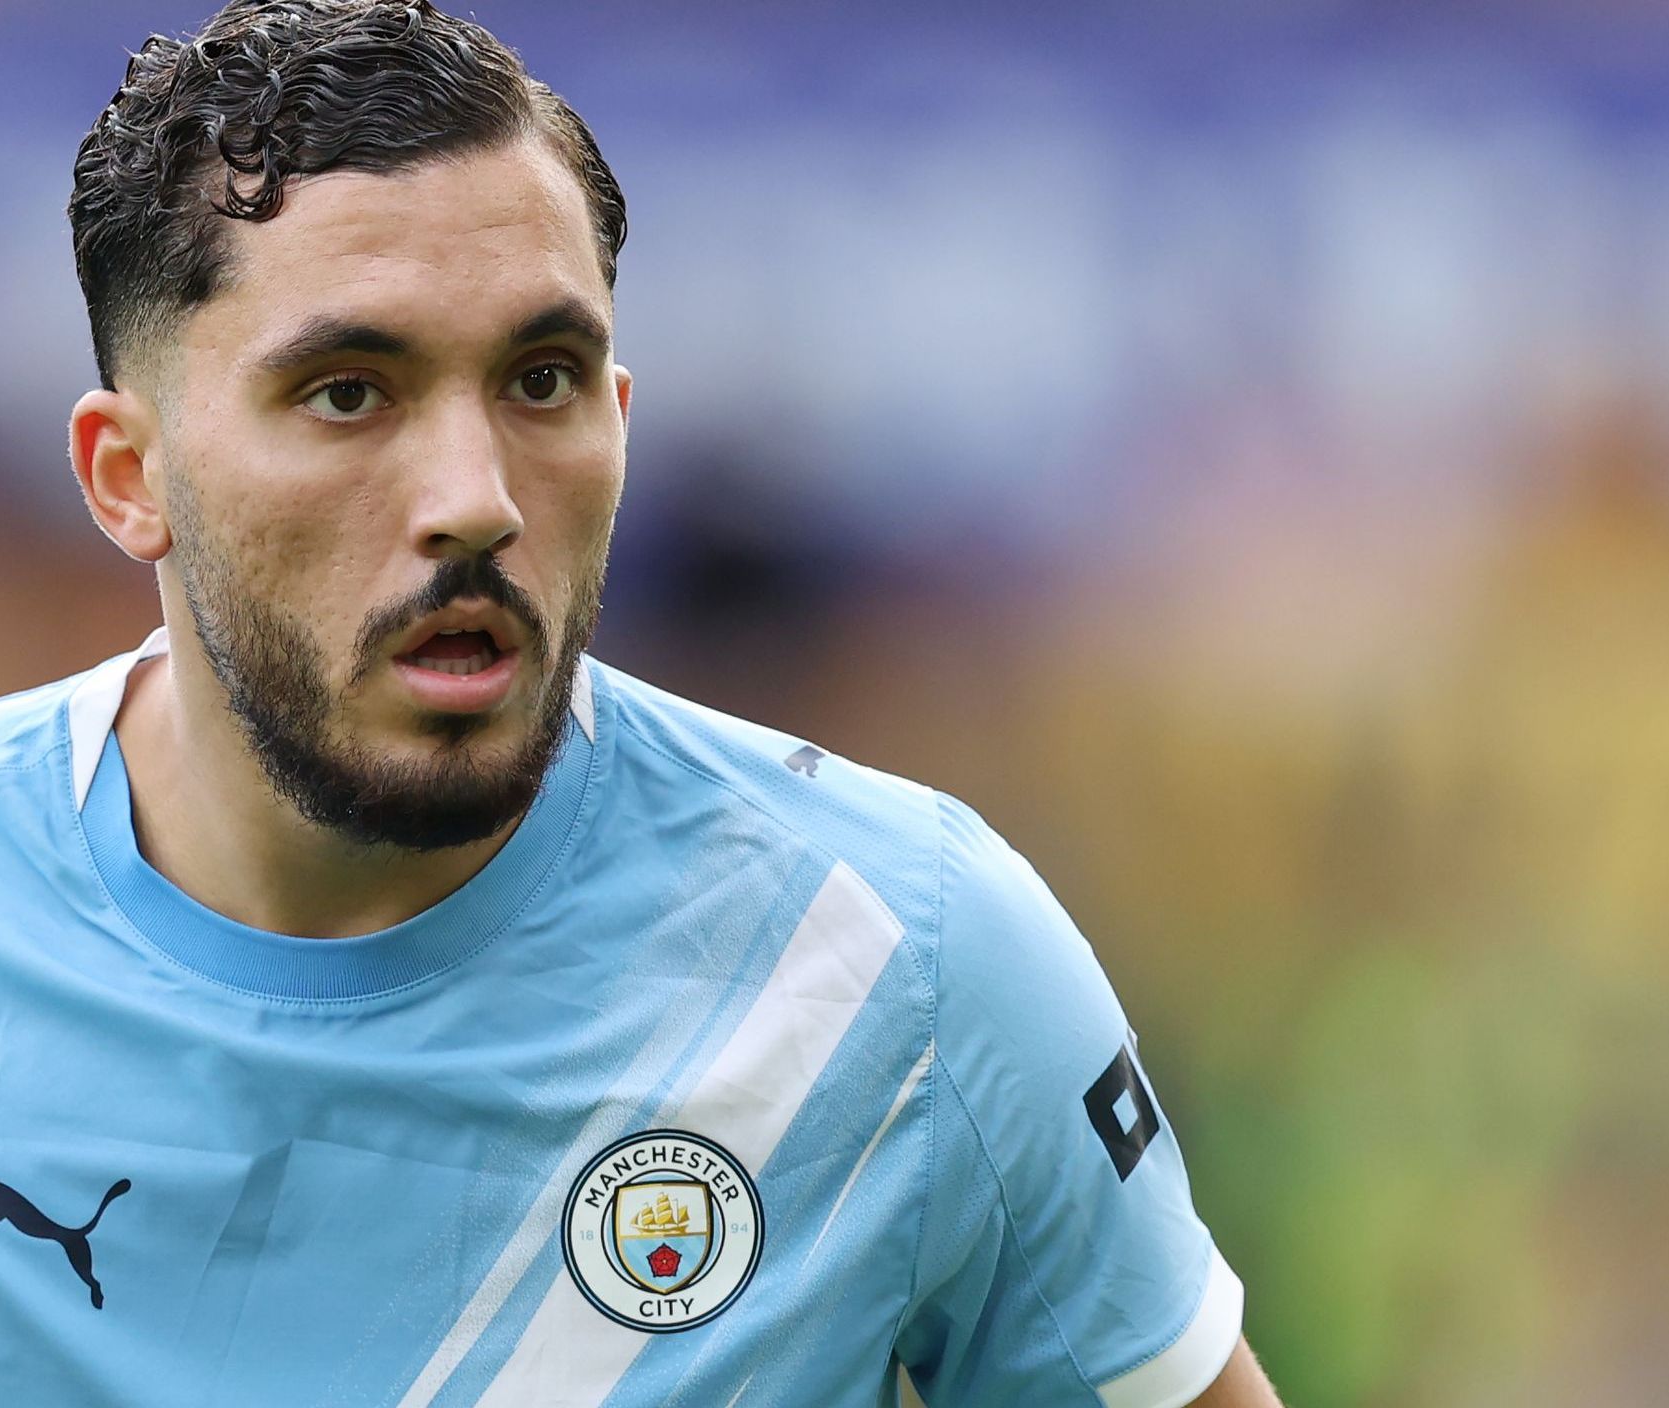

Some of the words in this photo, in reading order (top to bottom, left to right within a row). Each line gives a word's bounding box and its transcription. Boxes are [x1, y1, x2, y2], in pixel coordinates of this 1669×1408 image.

[584, 1145, 740, 1208] MANCHESTER
[730, 1222, 748, 1234] 94
[638, 1298, 695, 1318] CITY
